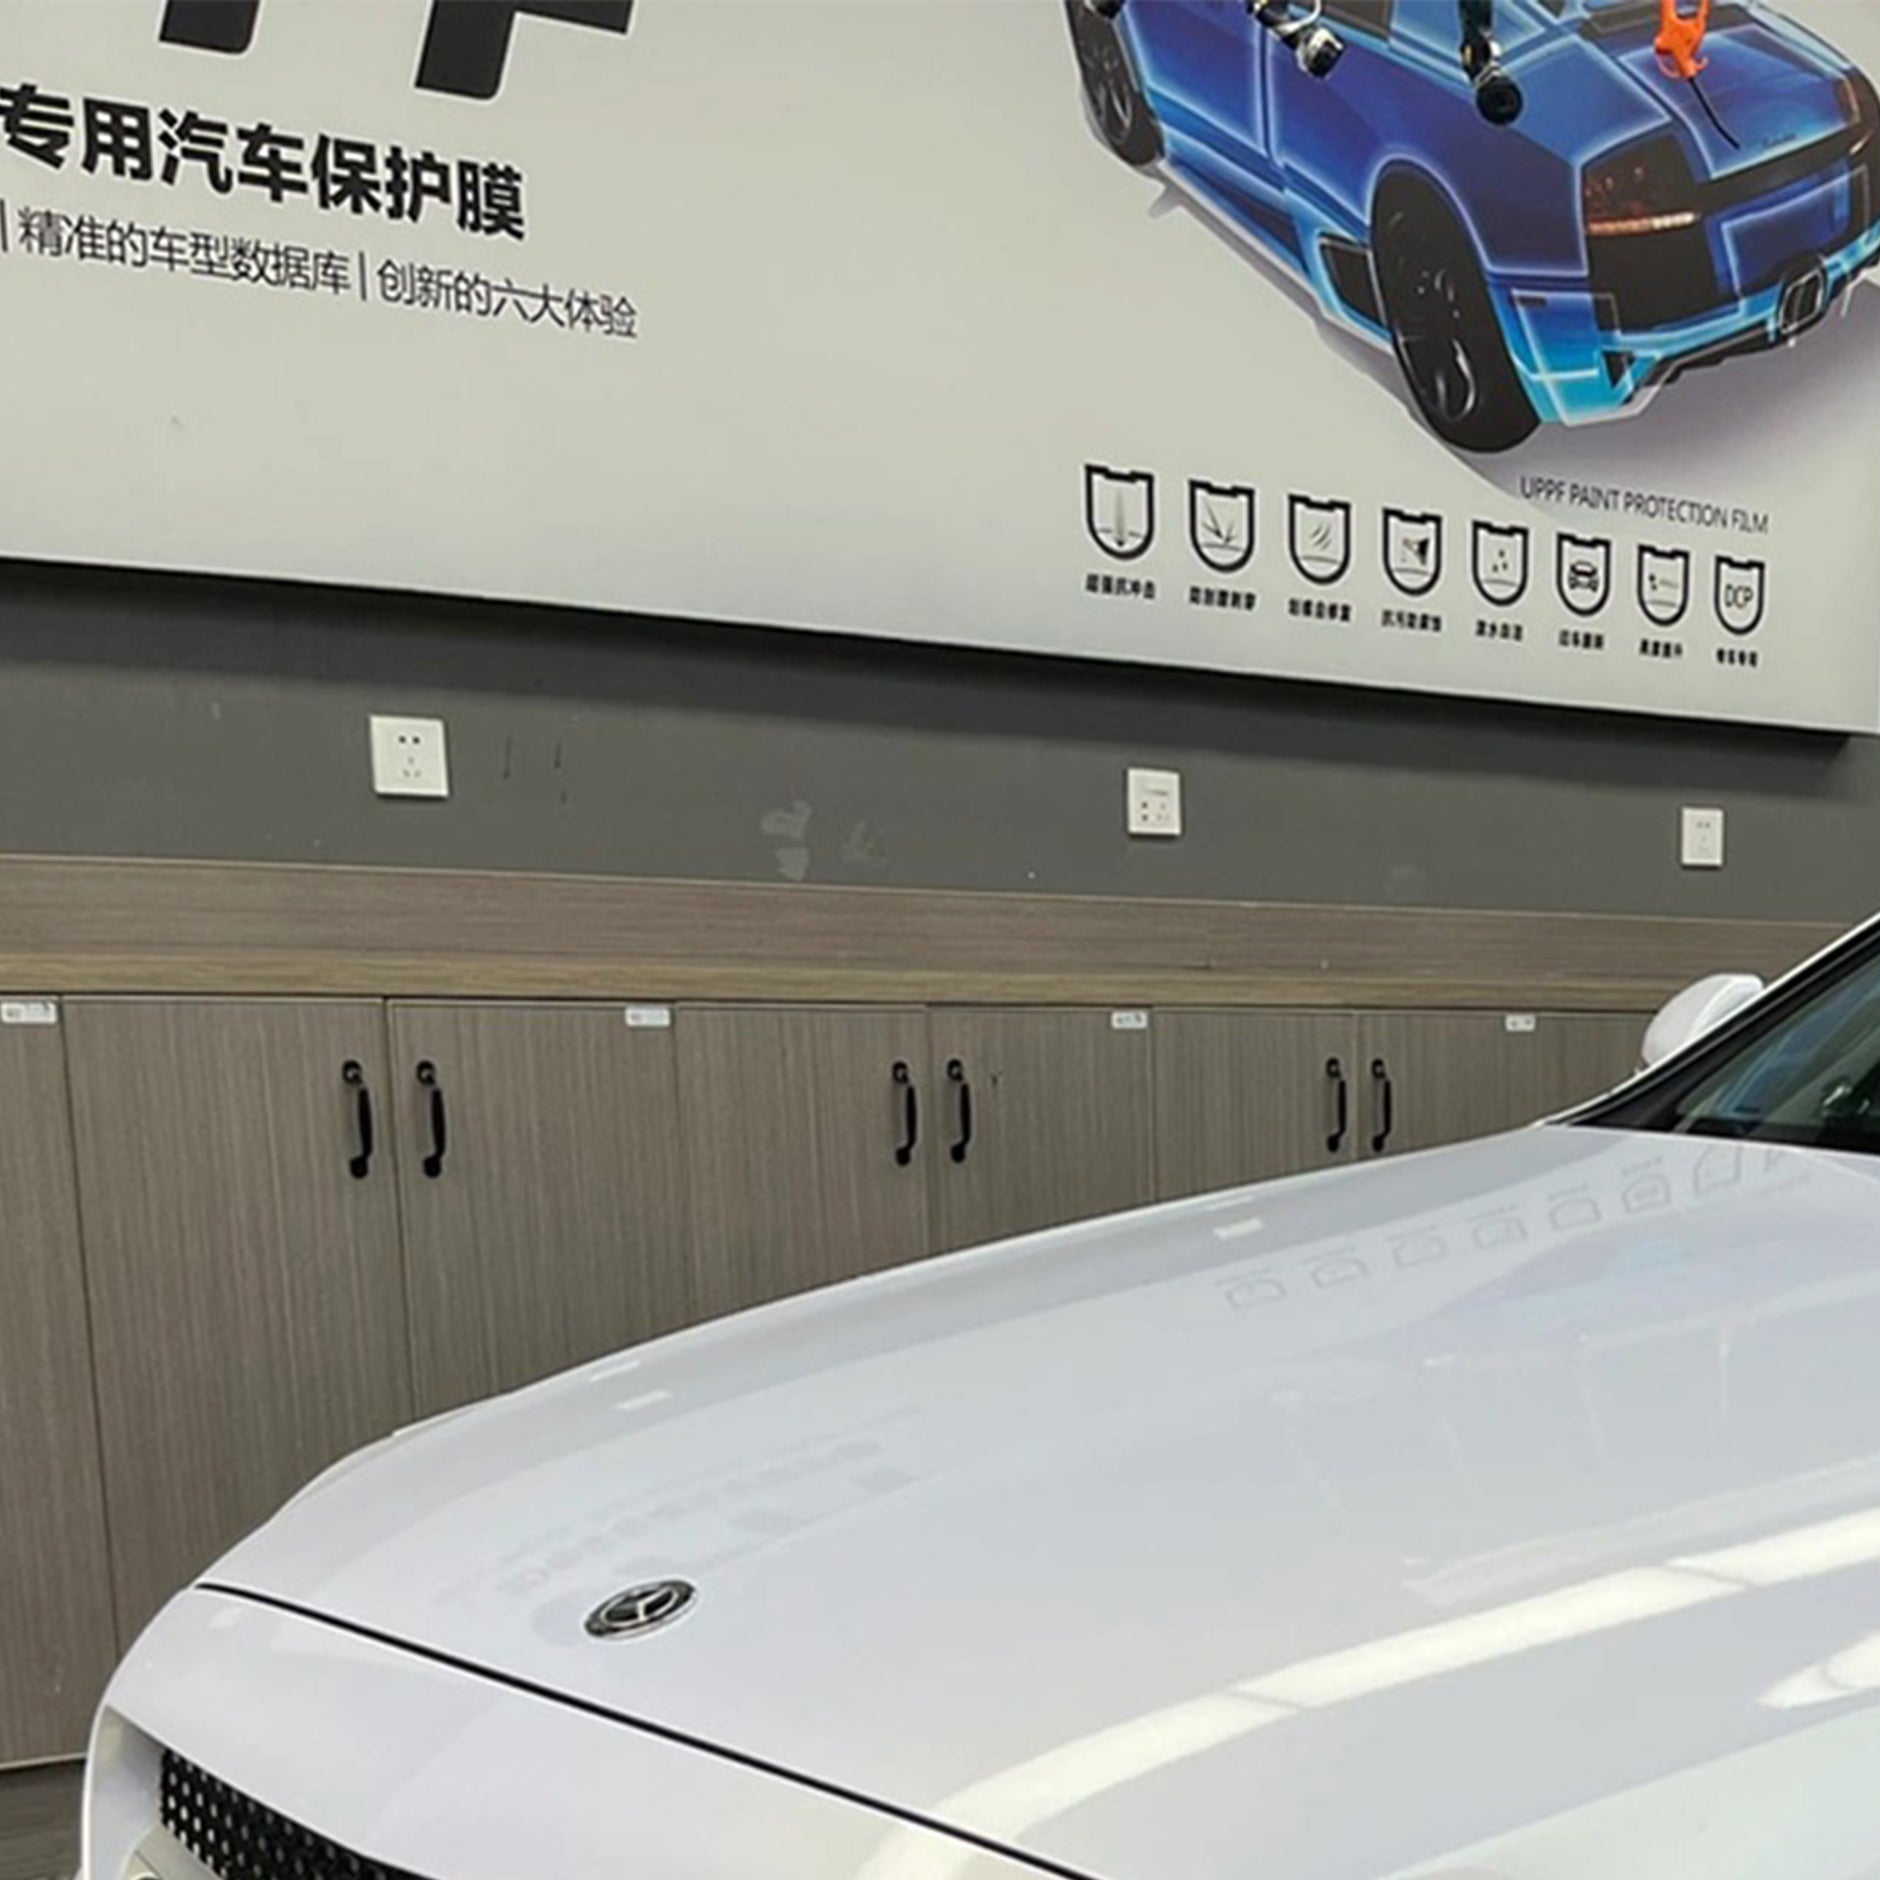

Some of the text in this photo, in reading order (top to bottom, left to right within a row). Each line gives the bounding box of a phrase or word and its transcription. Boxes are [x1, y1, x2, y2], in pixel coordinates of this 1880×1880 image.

[0, 83, 525, 240] 专用汽车保护膜
[18, 206, 637, 337] 精准的车型数据库 创新的六大体验
[1519, 476, 1769, 533] UPPF PAINT PROTECTION FILM
[1724, 583, 1754, 609] DCP
